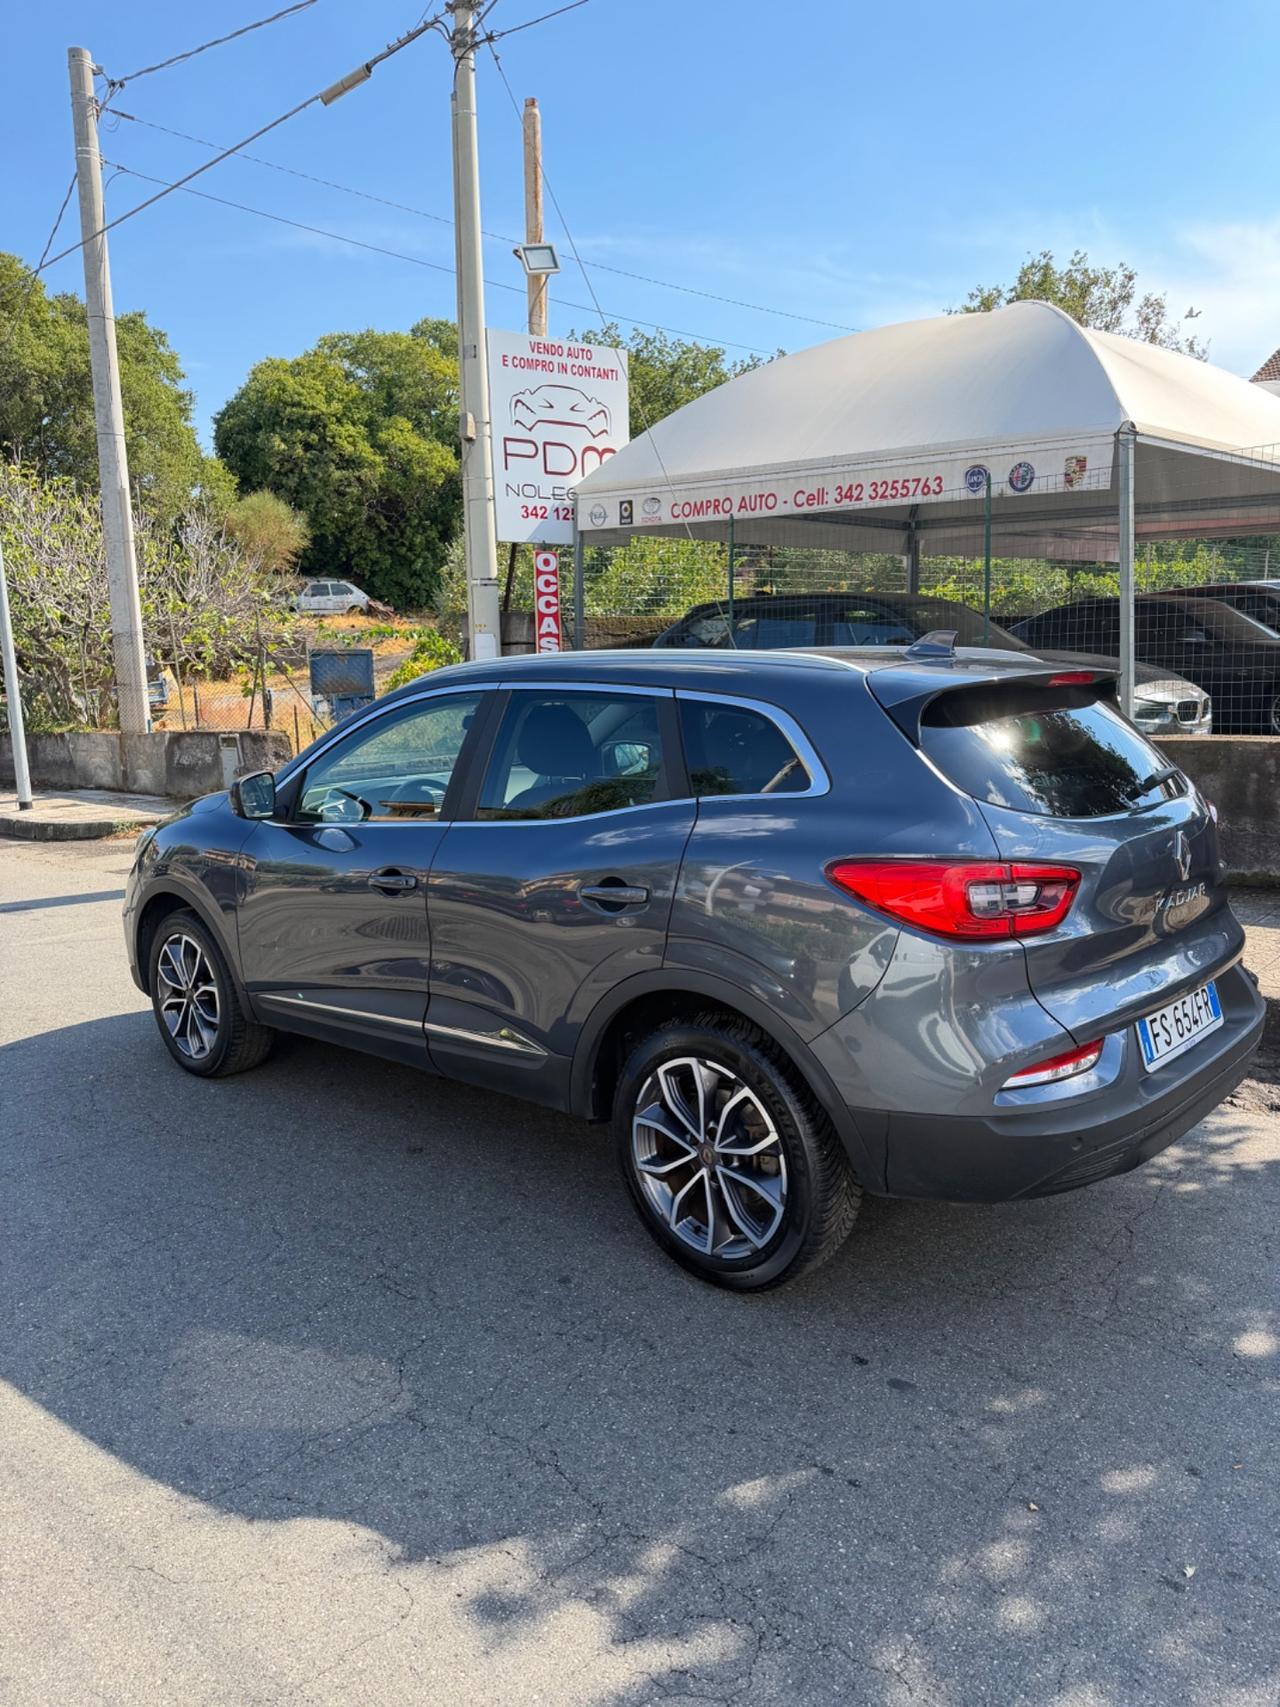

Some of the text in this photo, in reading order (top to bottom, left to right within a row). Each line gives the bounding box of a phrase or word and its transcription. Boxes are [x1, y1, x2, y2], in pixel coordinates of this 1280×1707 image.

[529, 341, 593, 361] VENDO AUTO
[502, 355, 619, 381] E COMPRO IN CONTANTI
[671, 500, 733, 519] COMPRO
[737, 492, 777, 512] AUTO
[793, 487, 829, 506] Cell:
[834, 483, 864, 504] 342
[868, 475, 944, 499] 3255763
[521, 505, 548, 519] 342
[1155, 882, 1206, 912] KADJAR
